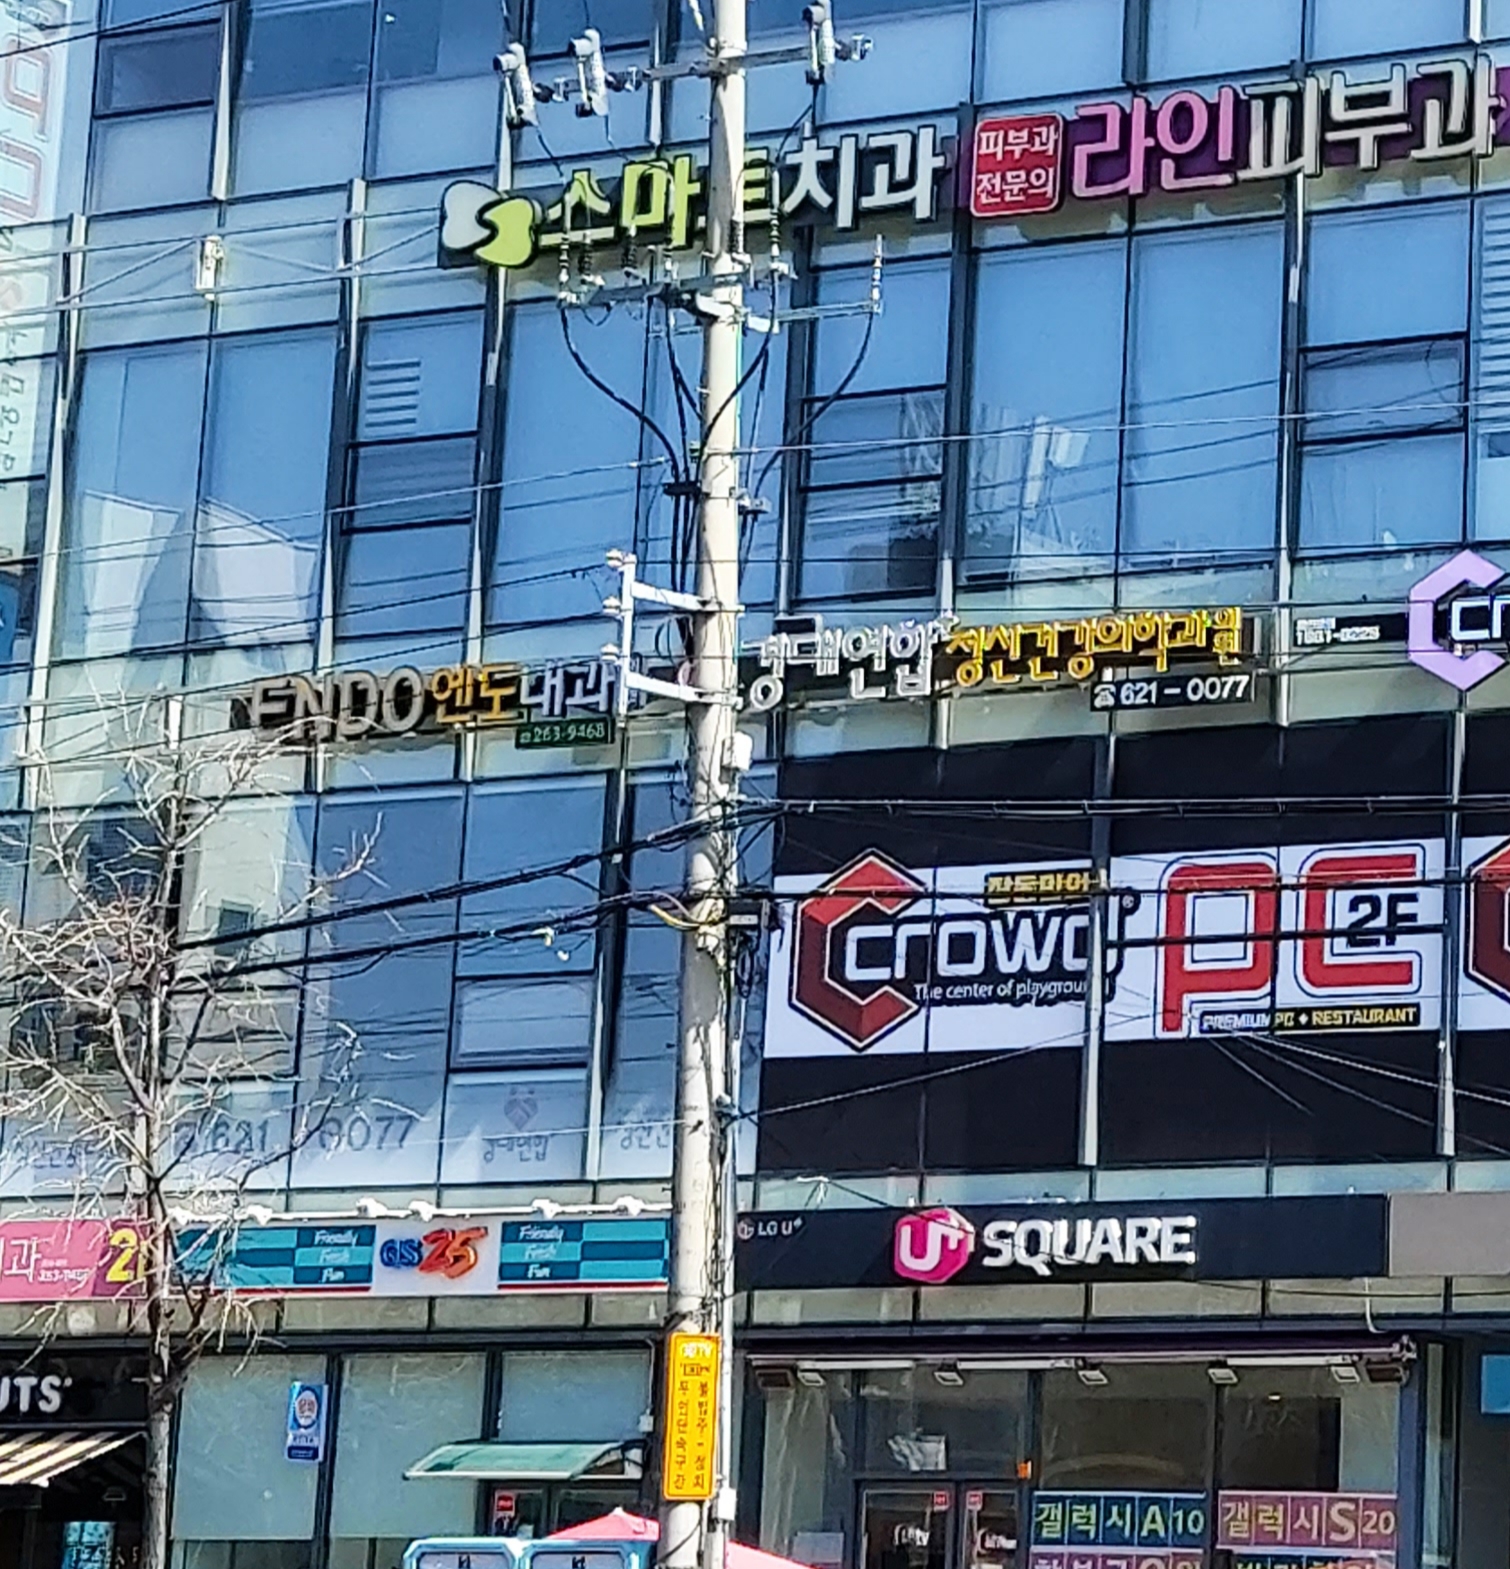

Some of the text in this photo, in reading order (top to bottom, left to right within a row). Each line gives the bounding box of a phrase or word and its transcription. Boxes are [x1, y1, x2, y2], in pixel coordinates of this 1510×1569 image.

[977, 125, 1059, 162] 피부과
[1071, 52, 1502, 200] 라인피부과
[976, 164, 1056, 205] 전문의
[1160, 852, 1420, 1034] PC
[1346, 893, 1419, 947] 2F
[914, 982, 940, 1000] The
[946, 982, 994, 999] center
[997, 979, 1014, 997] of
[1202, 1012, 1270, 1029] PREMIUM
[1312, 1005, 1417, 1026] RESTAURANT
[379, 1226, 488, 1280] GS25
[982, 1215, 1198, 1277] SQUARE
[1222, 1498, 1397, 1544] 갤럭시S20
